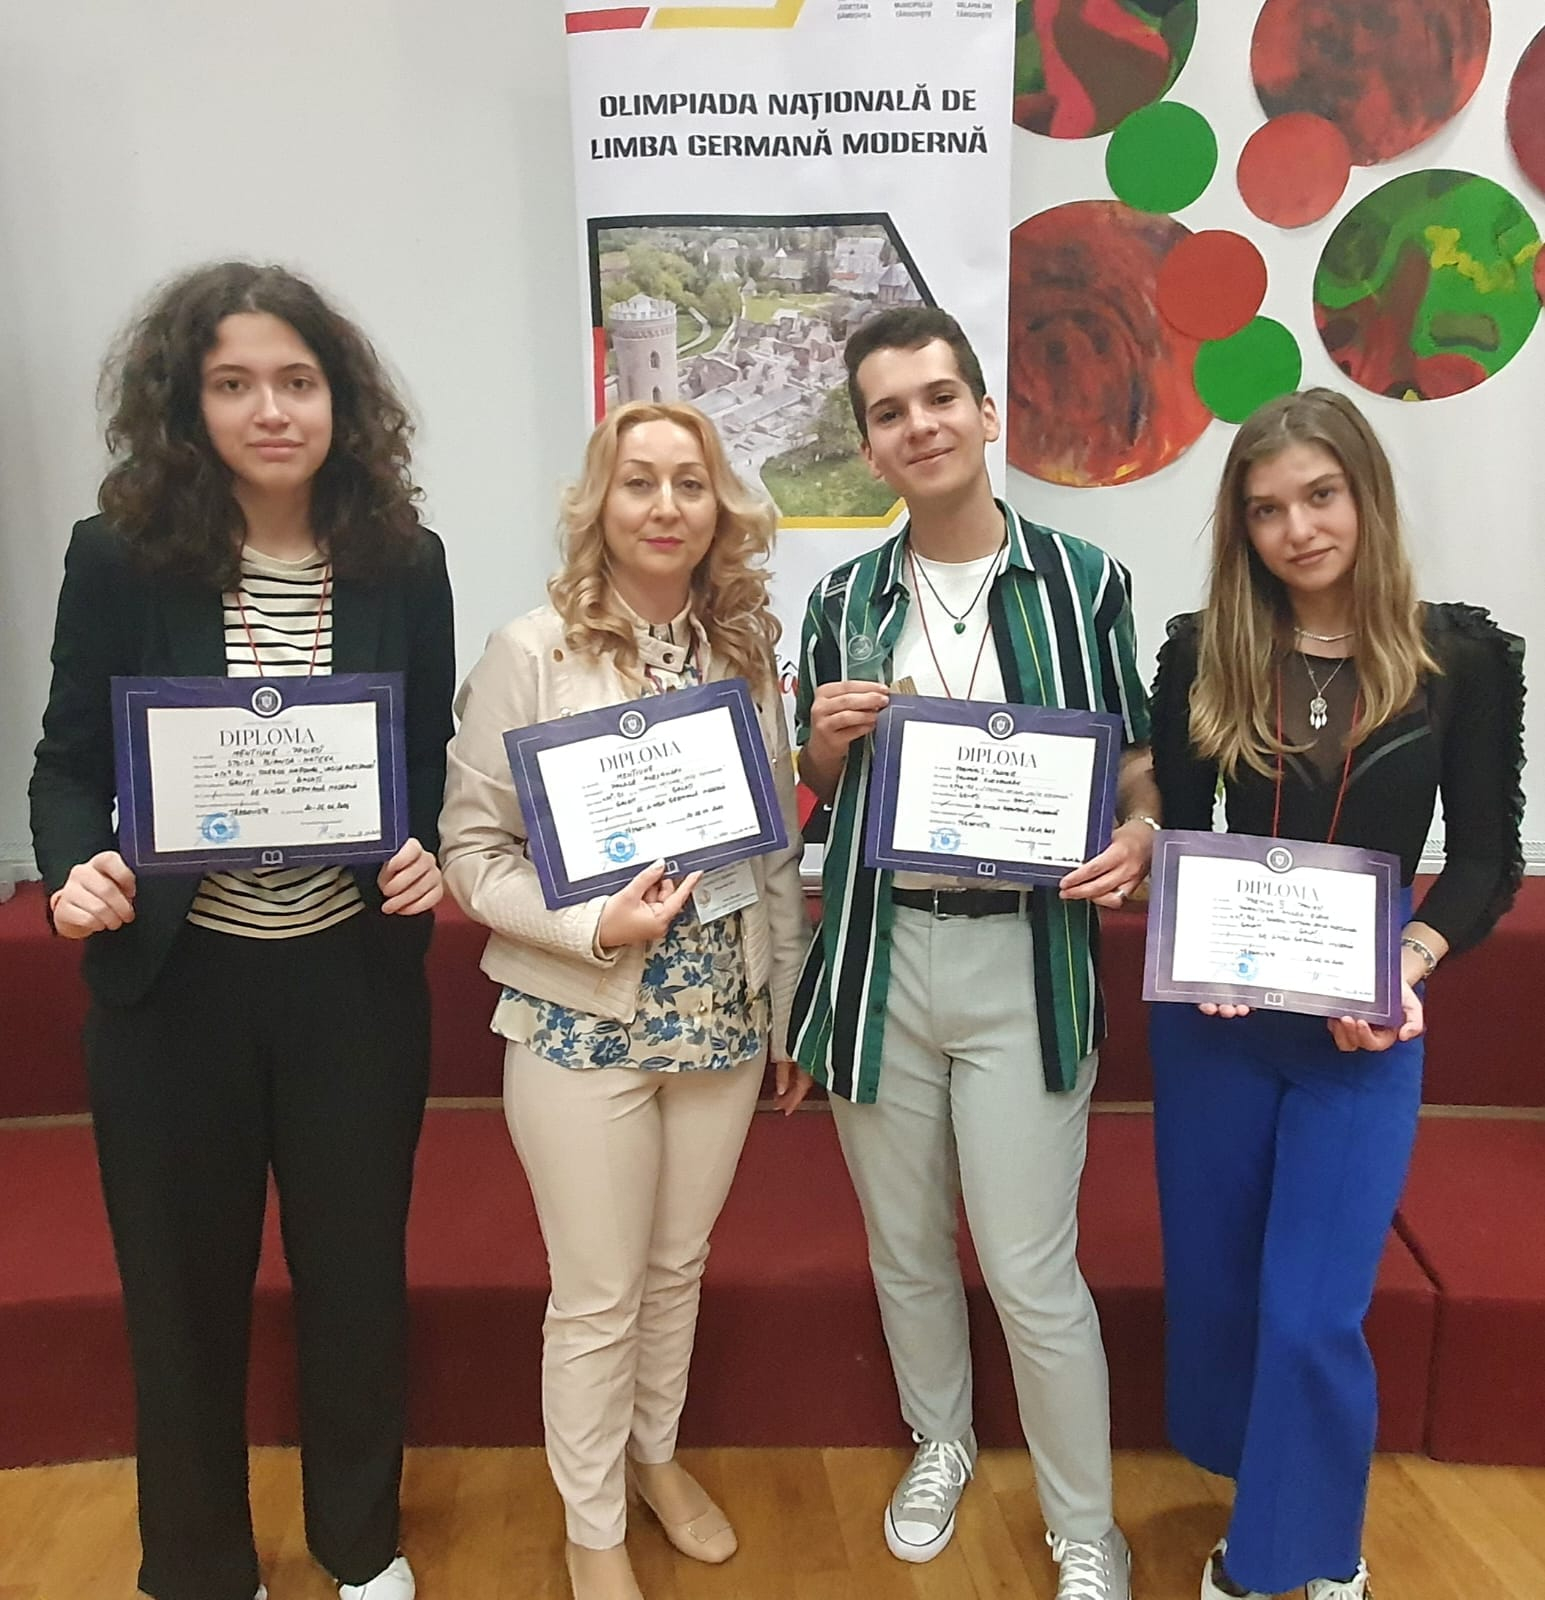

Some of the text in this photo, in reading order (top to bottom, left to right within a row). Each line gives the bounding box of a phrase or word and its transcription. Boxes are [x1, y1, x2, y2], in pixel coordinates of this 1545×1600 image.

[599, 93, 759, 118] OLIMPIADA
[942, 89, 977, 111] DE
[591, 126, 988, 159] LIMBA GERMANĂ MODERNĂ
[220, 728, 315, 747] DIPLOMA
[599, 741, 683, 773] DIPLOMA
[957, 746, 1037, 768] DIPLOMA
[1237, 879, 1319, 901] DIPLOMA
